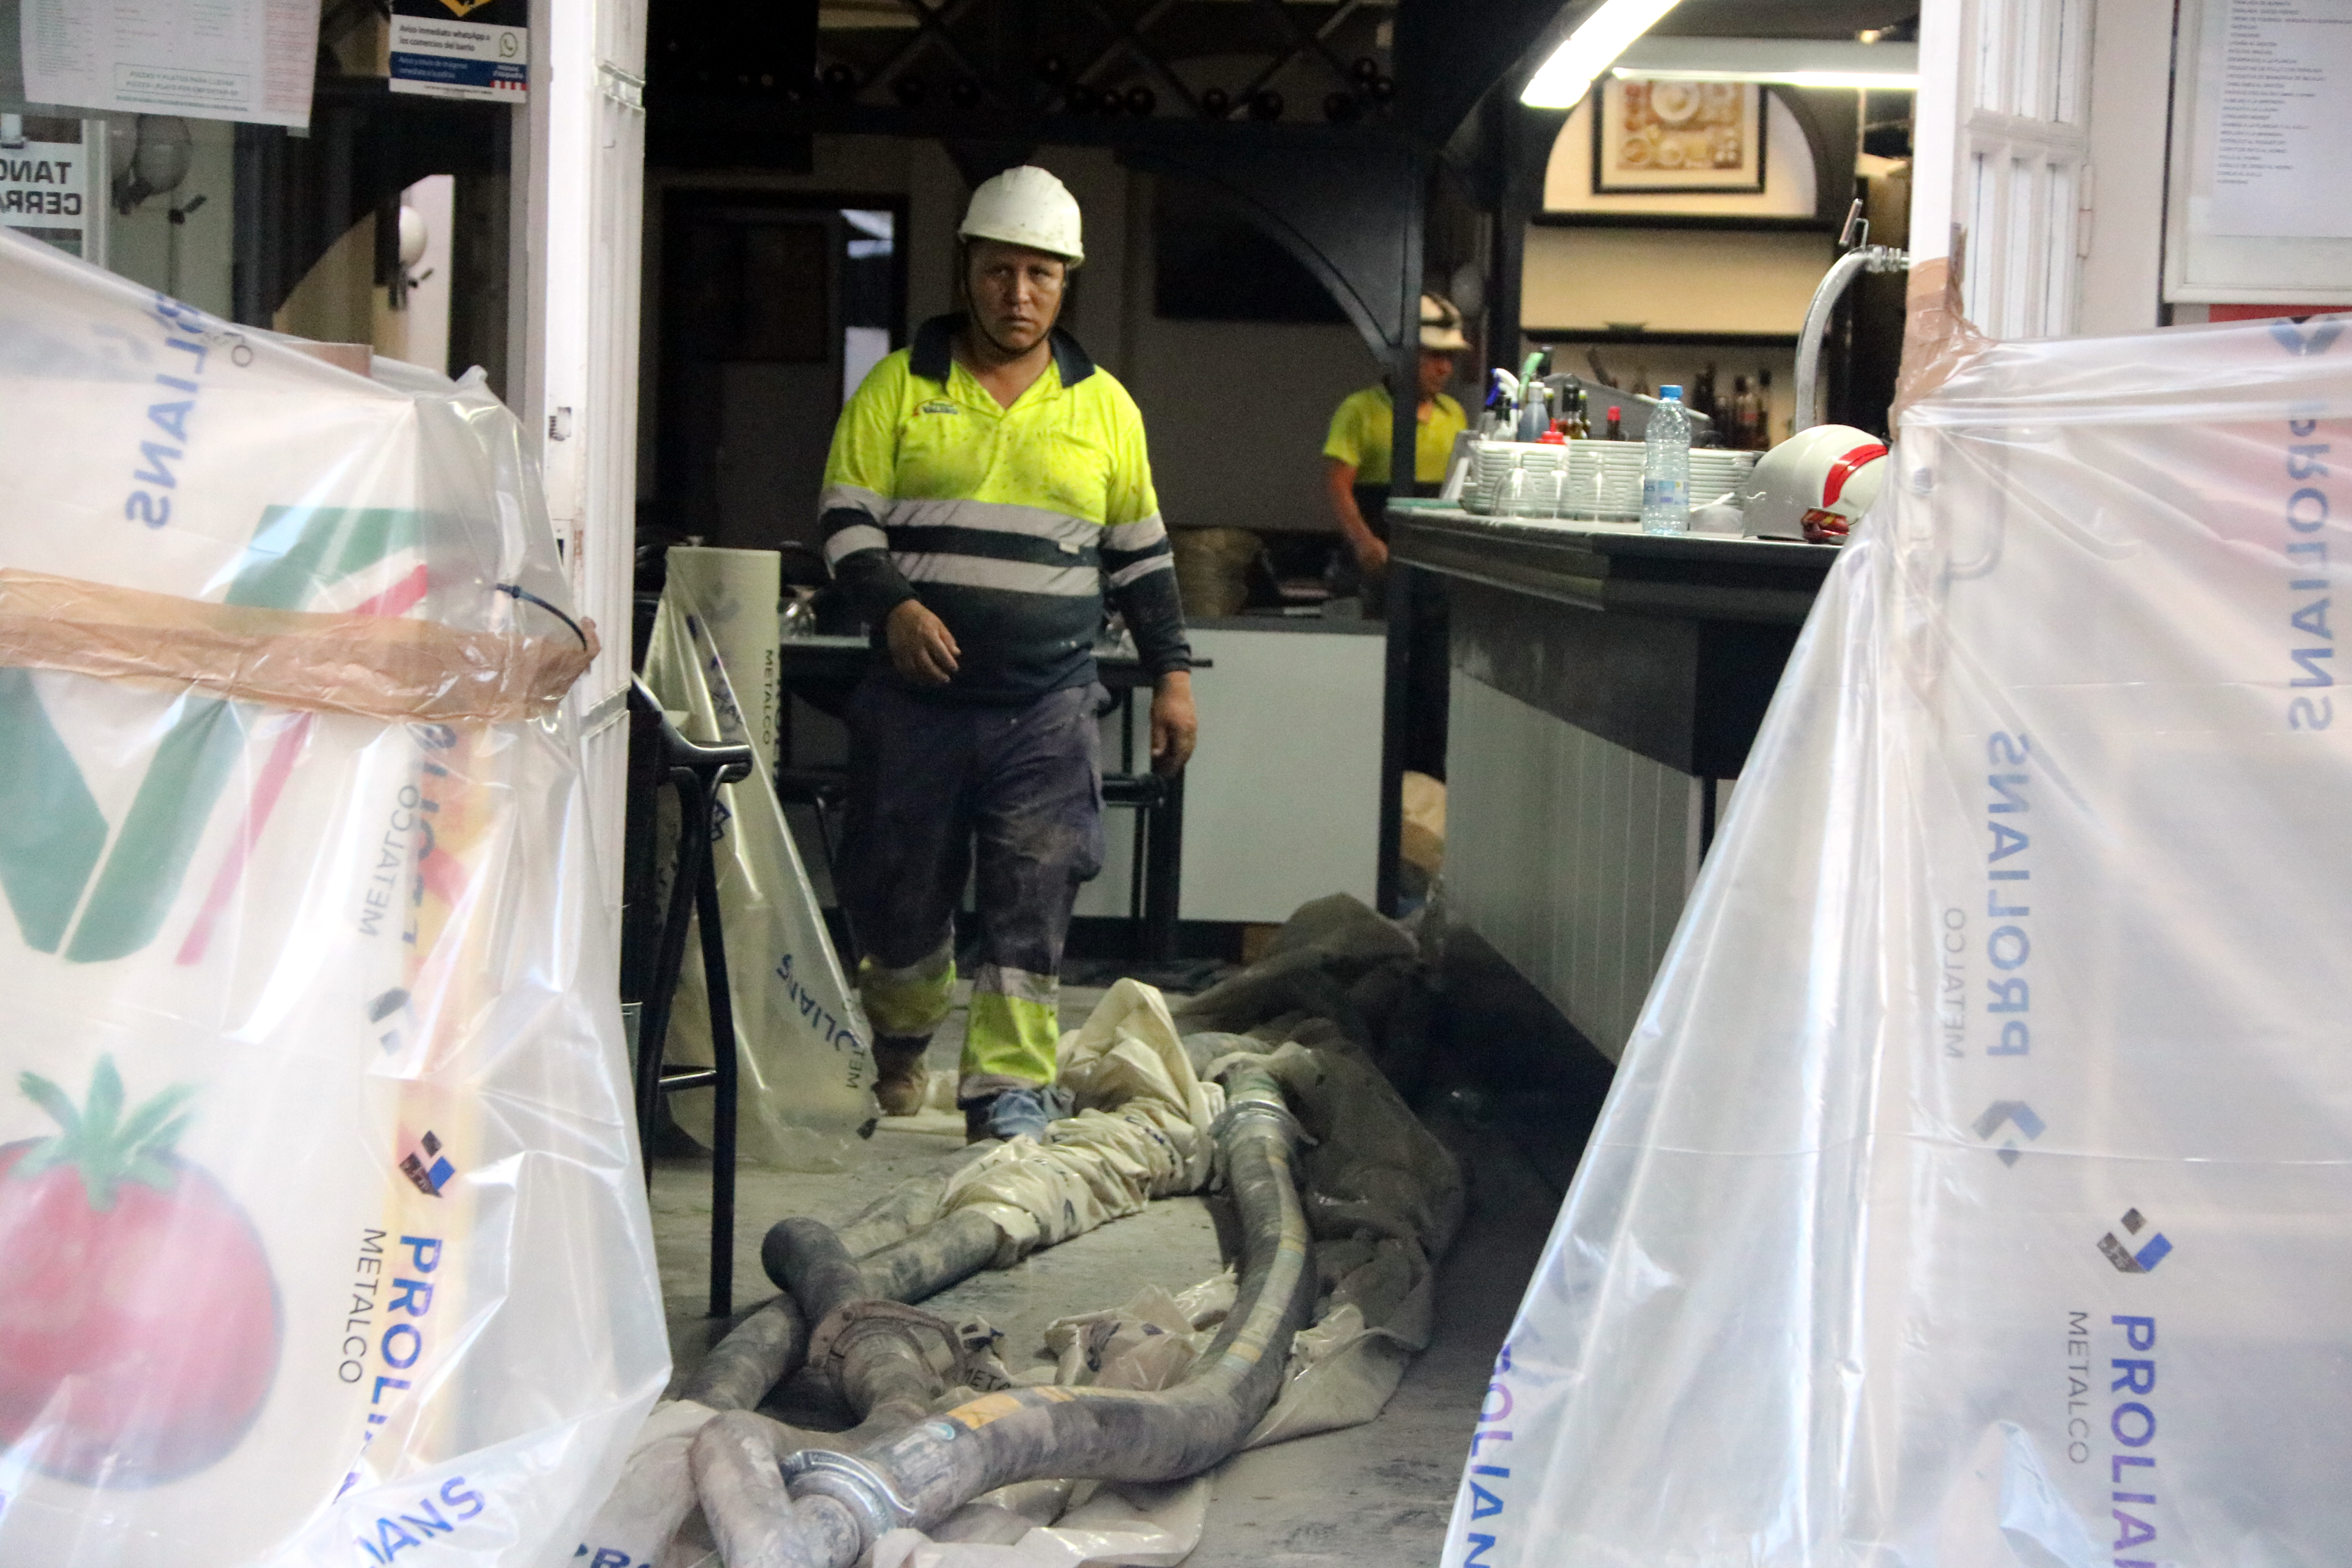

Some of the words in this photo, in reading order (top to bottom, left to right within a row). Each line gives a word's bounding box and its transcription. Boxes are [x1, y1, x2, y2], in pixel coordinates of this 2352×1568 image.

[338, 1228, 387, 1384] METALCO
[2067, 1311, 2089, 1464] METALCO
[2110, 1314, 2157, 1568] PROLIA
